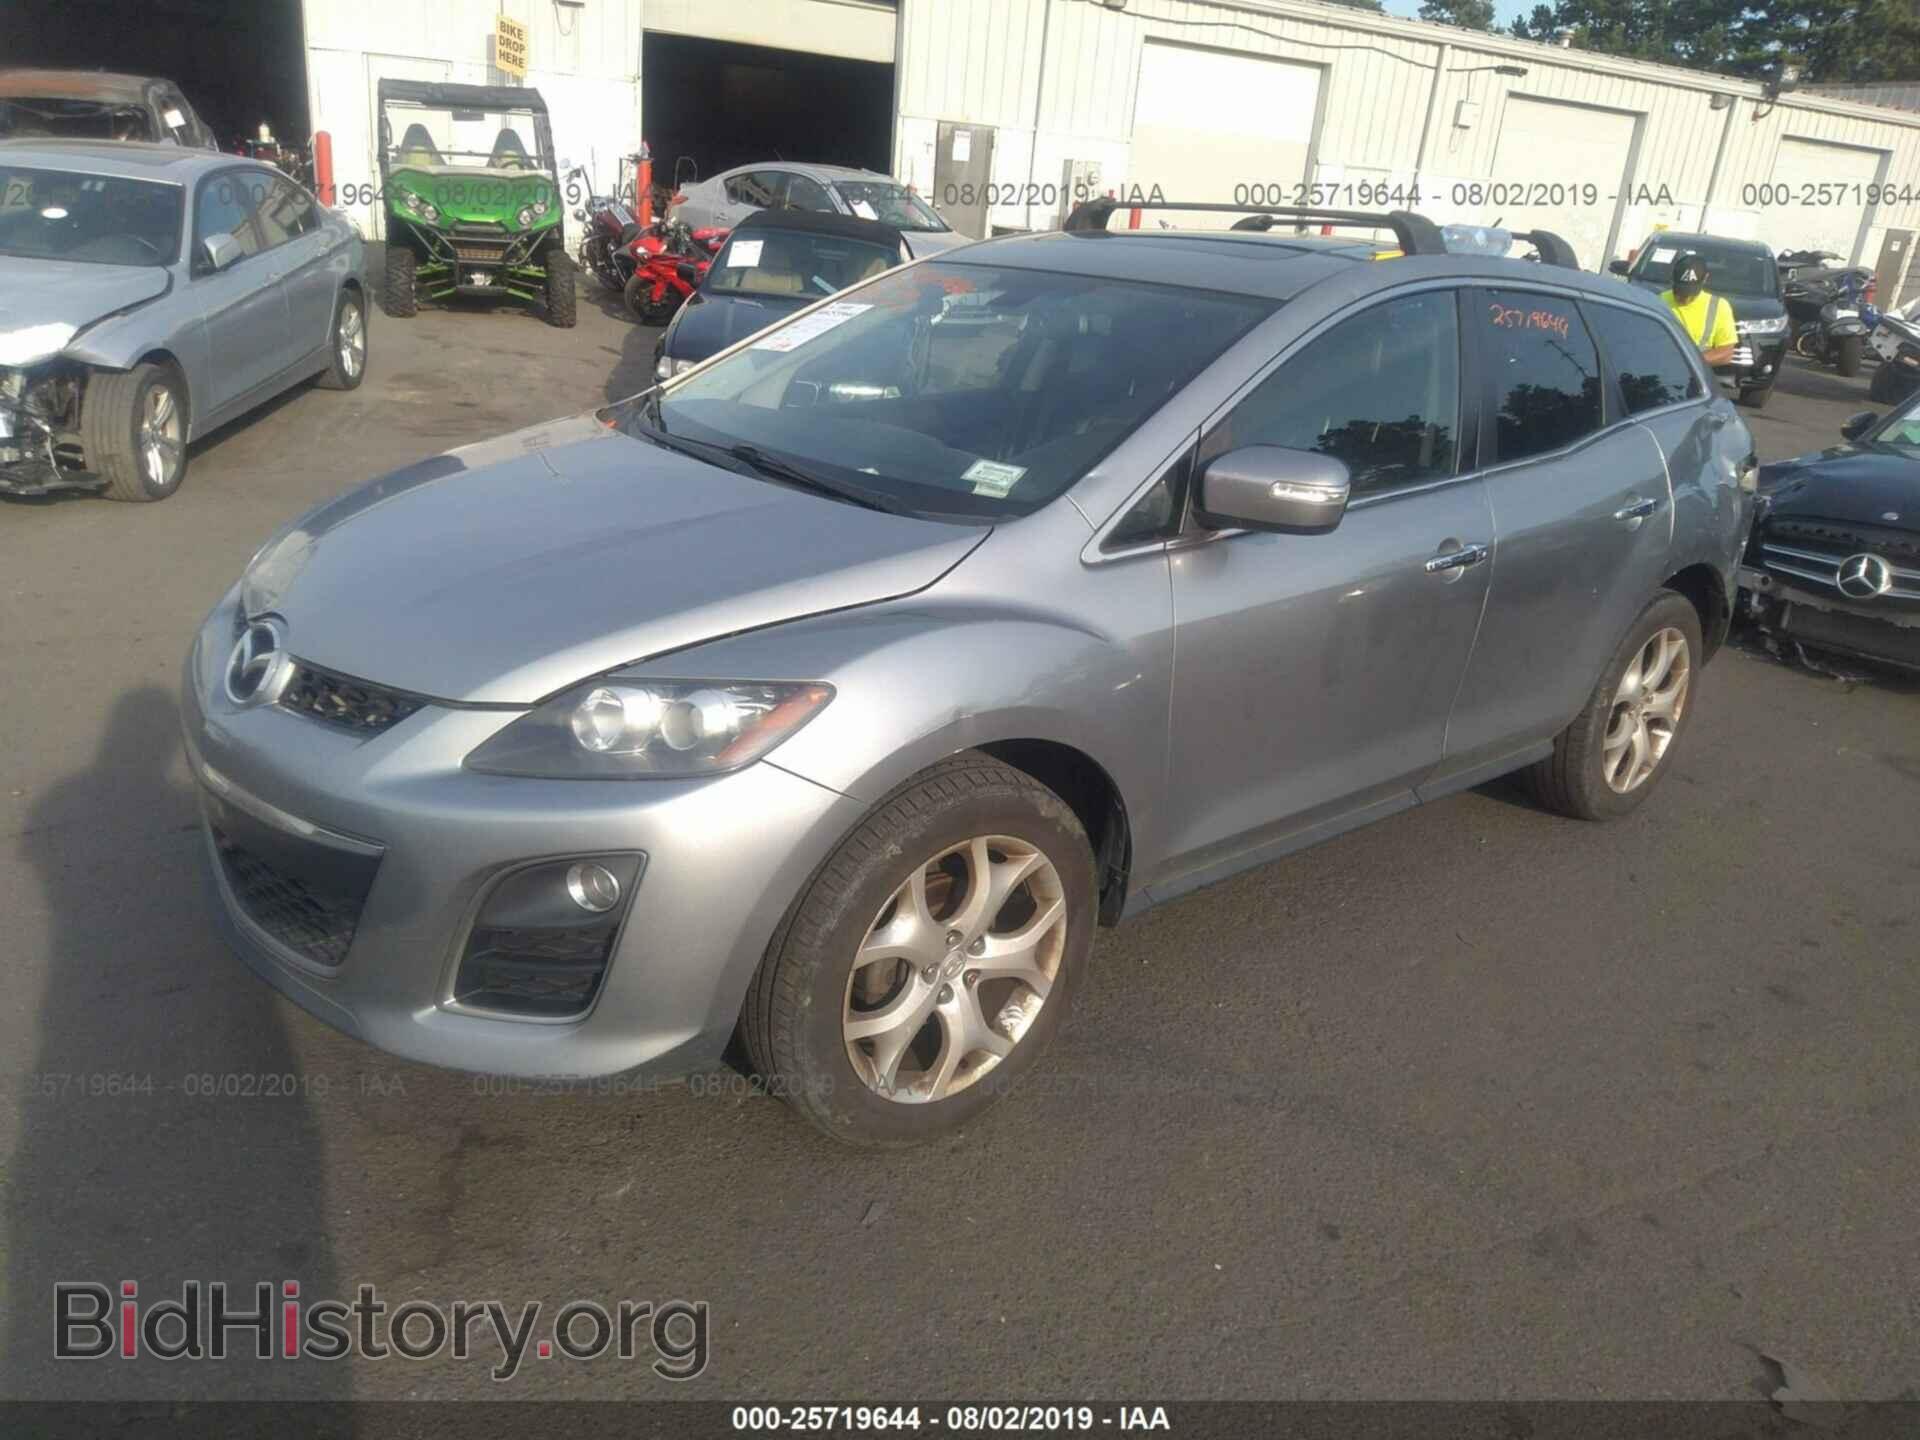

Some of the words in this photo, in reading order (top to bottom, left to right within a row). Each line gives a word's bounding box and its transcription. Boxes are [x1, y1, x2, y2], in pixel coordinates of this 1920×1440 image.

[499, 20, 524, 41] BIKE
[498, 34, 526, 54] DROP
[498, 48, 525, 69] HERE
